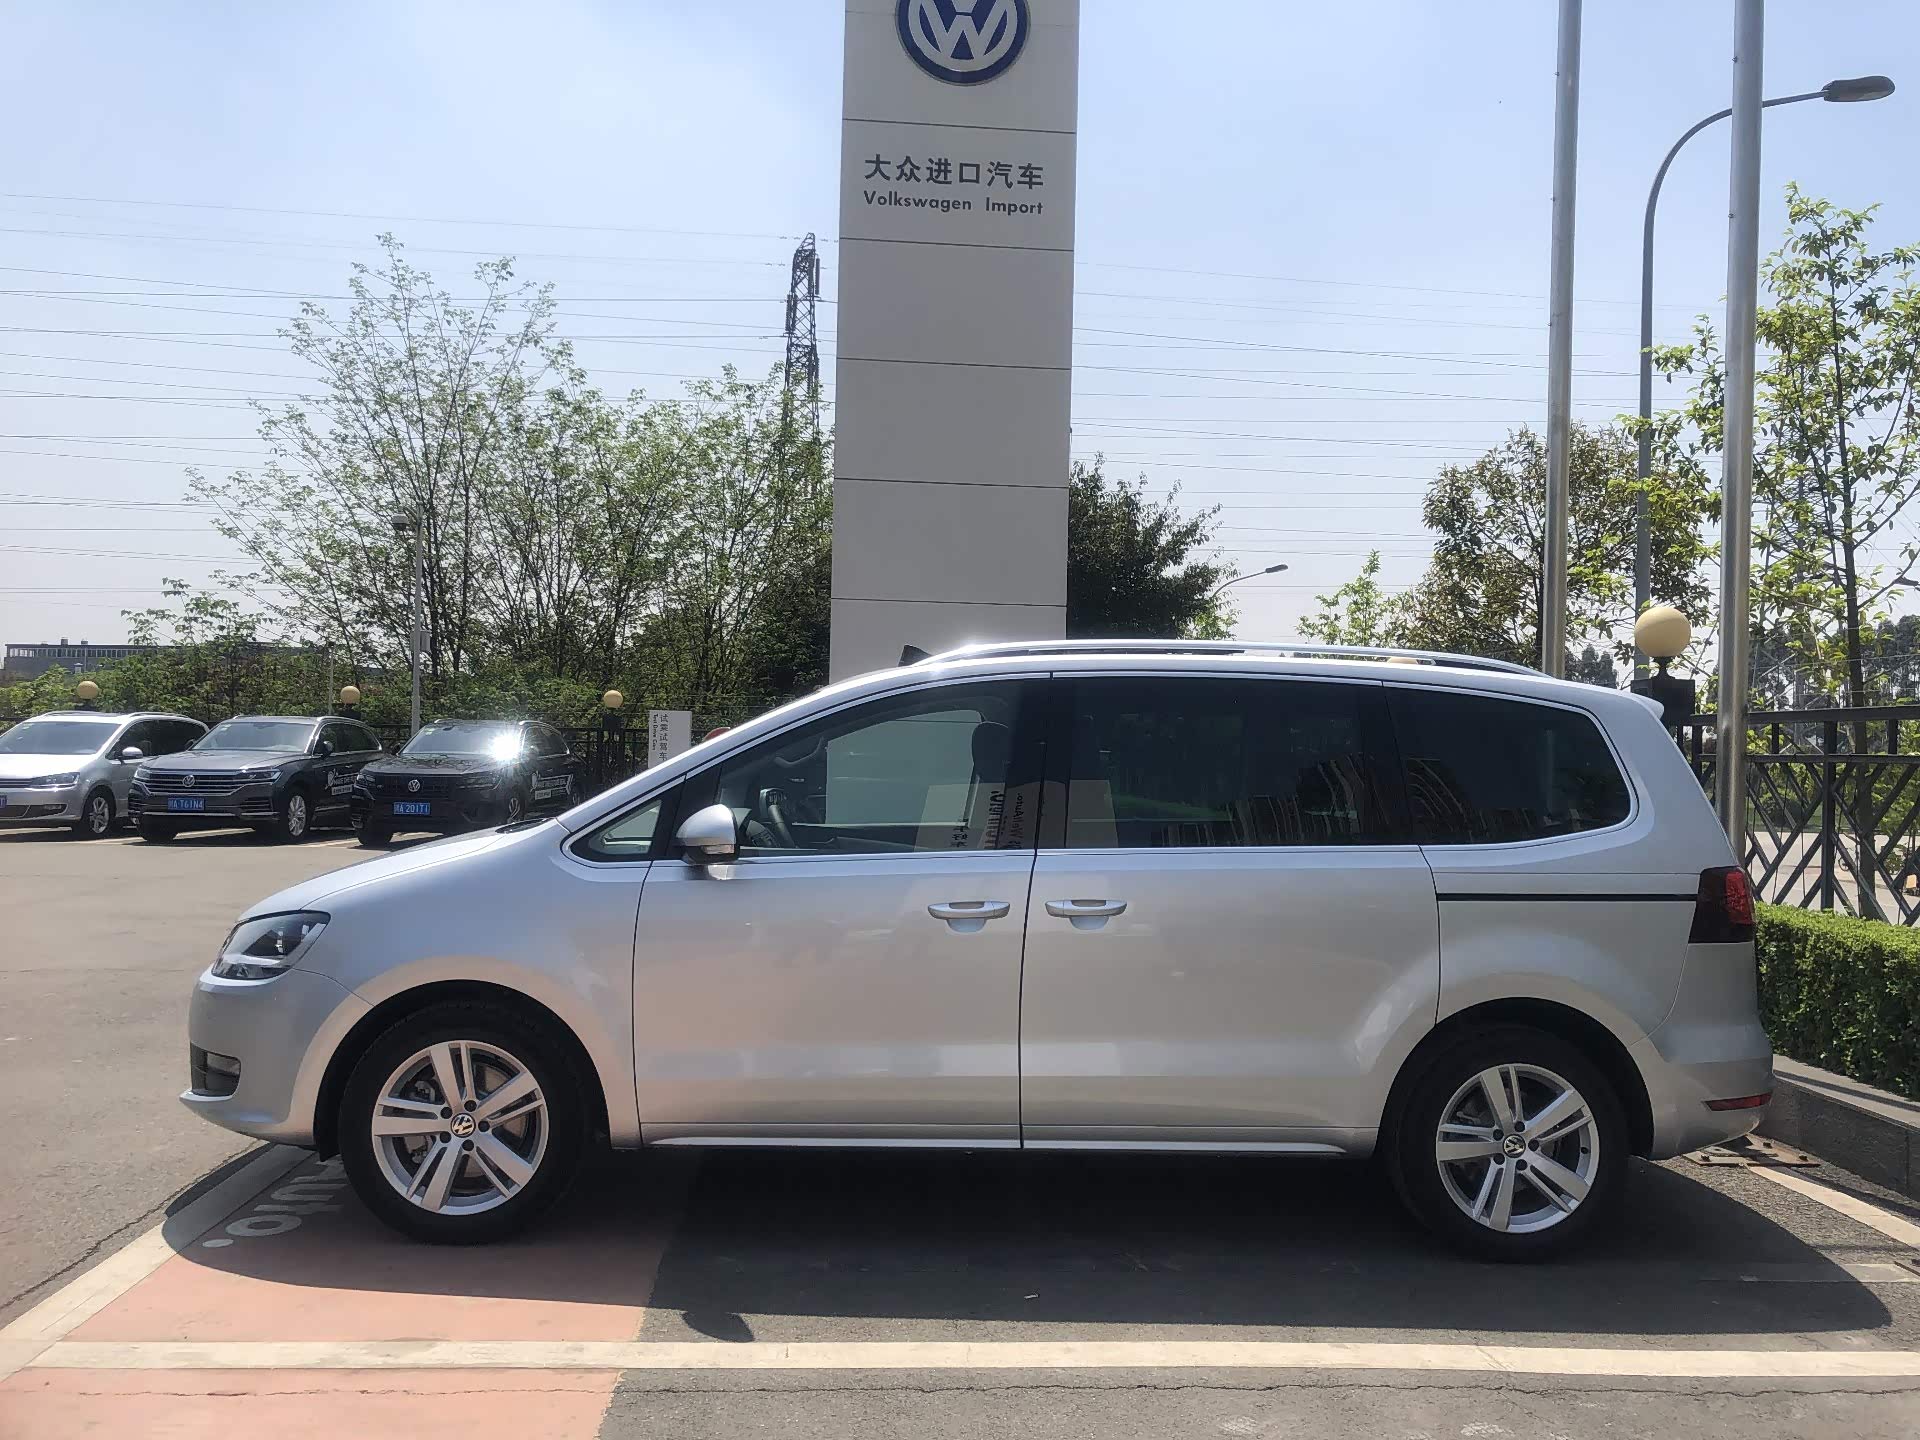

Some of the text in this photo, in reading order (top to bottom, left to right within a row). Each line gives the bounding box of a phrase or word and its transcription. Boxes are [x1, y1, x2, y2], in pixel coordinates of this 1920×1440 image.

[864, 153, 1044, 190] 大众进口汽车
[863, 190, 1043, 216] Volkswagen Import
